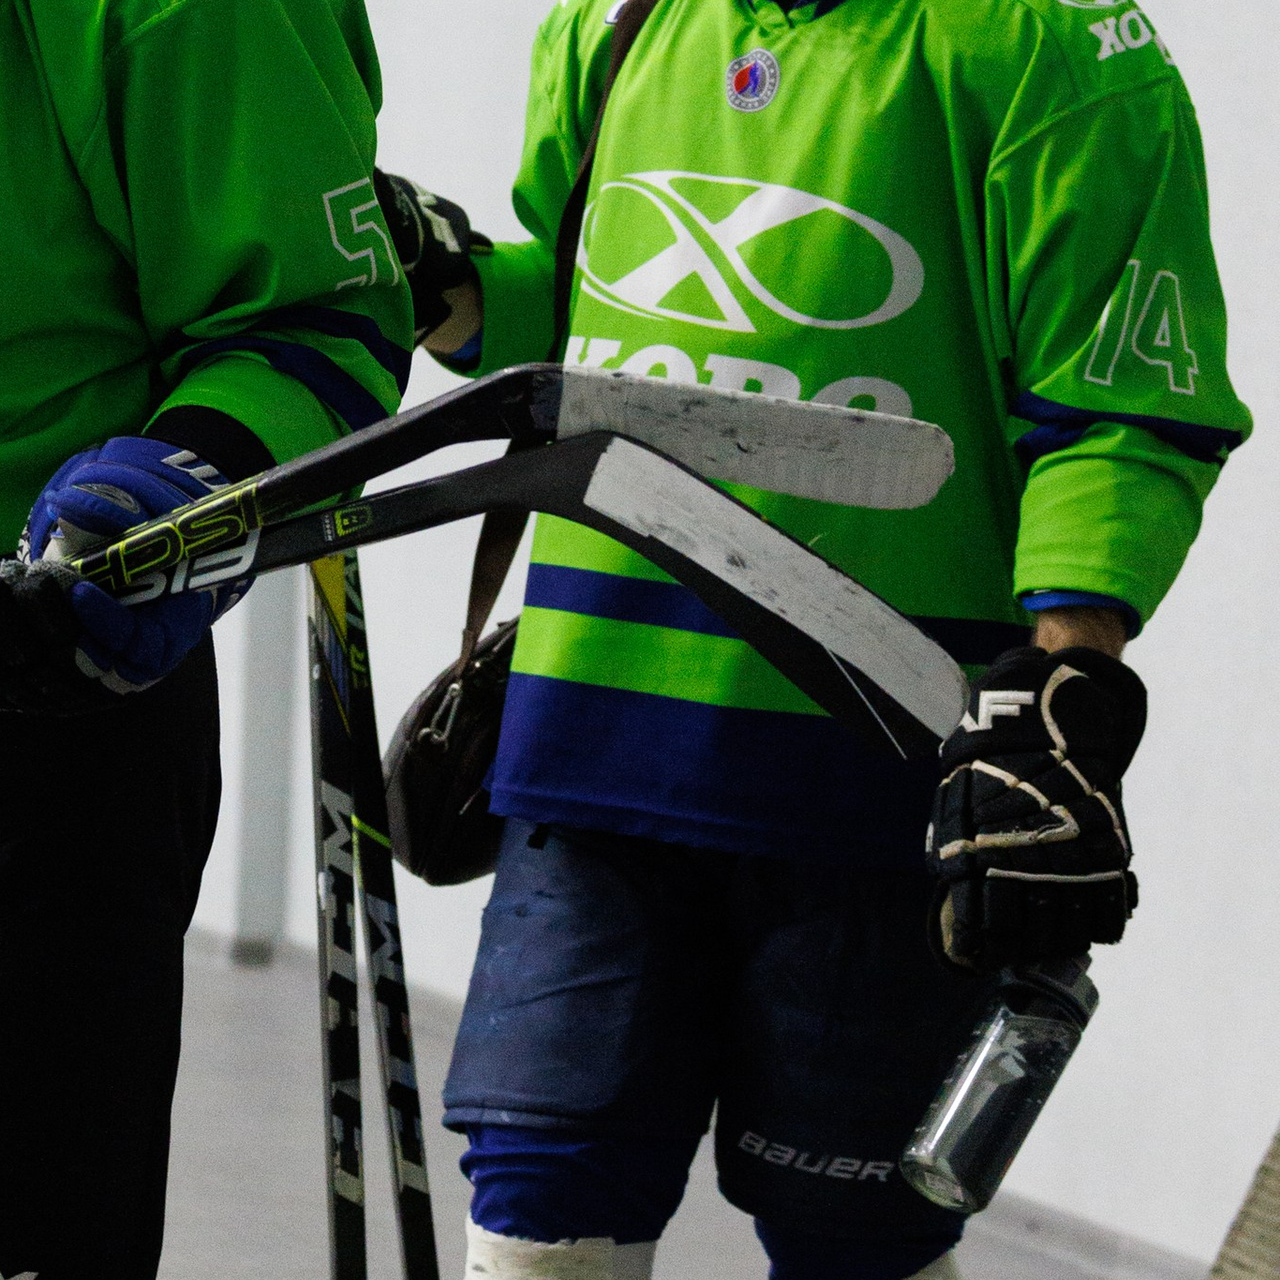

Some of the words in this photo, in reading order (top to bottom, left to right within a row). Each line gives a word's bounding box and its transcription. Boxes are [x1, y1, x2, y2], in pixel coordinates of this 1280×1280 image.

[322, 176, 400, 292] 5
[1083, 258, 1199, 396] 14
[737, 1130, 895, 1183] BAUER
